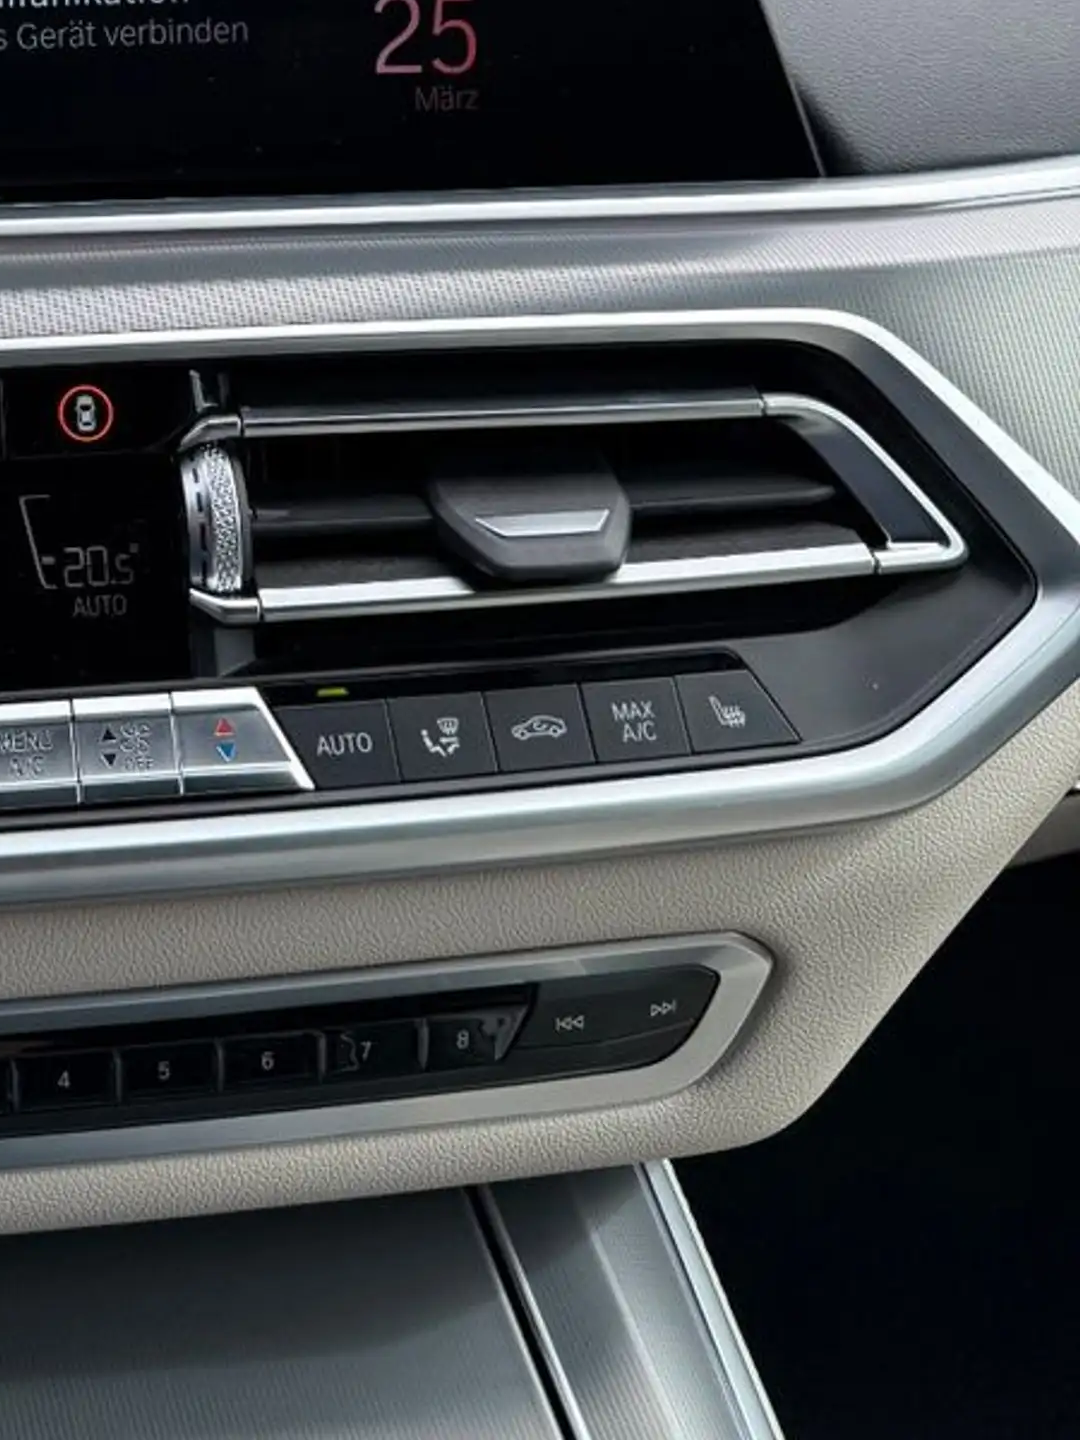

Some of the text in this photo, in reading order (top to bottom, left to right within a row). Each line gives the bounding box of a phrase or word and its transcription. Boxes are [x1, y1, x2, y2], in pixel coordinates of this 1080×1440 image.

[16, 19, 97, 49] Gerät
[104, 15, 250, 47] verbinden
[414, 85, 480, 112] März
[72, 595, 128, 617] AUTO
[611, 701, 653, 721] MAX
[622, 722, 659, 742] A/C
[316, 732, 373, 756] AUTO
[455, 1029, 471, 1049] 8
[359, 1040, 373, 1060] 7
[156, 1061, 172, 1081] 5
[260, 1052, 275, 1071] 6
[55, 1070, 72, 1089] 4
